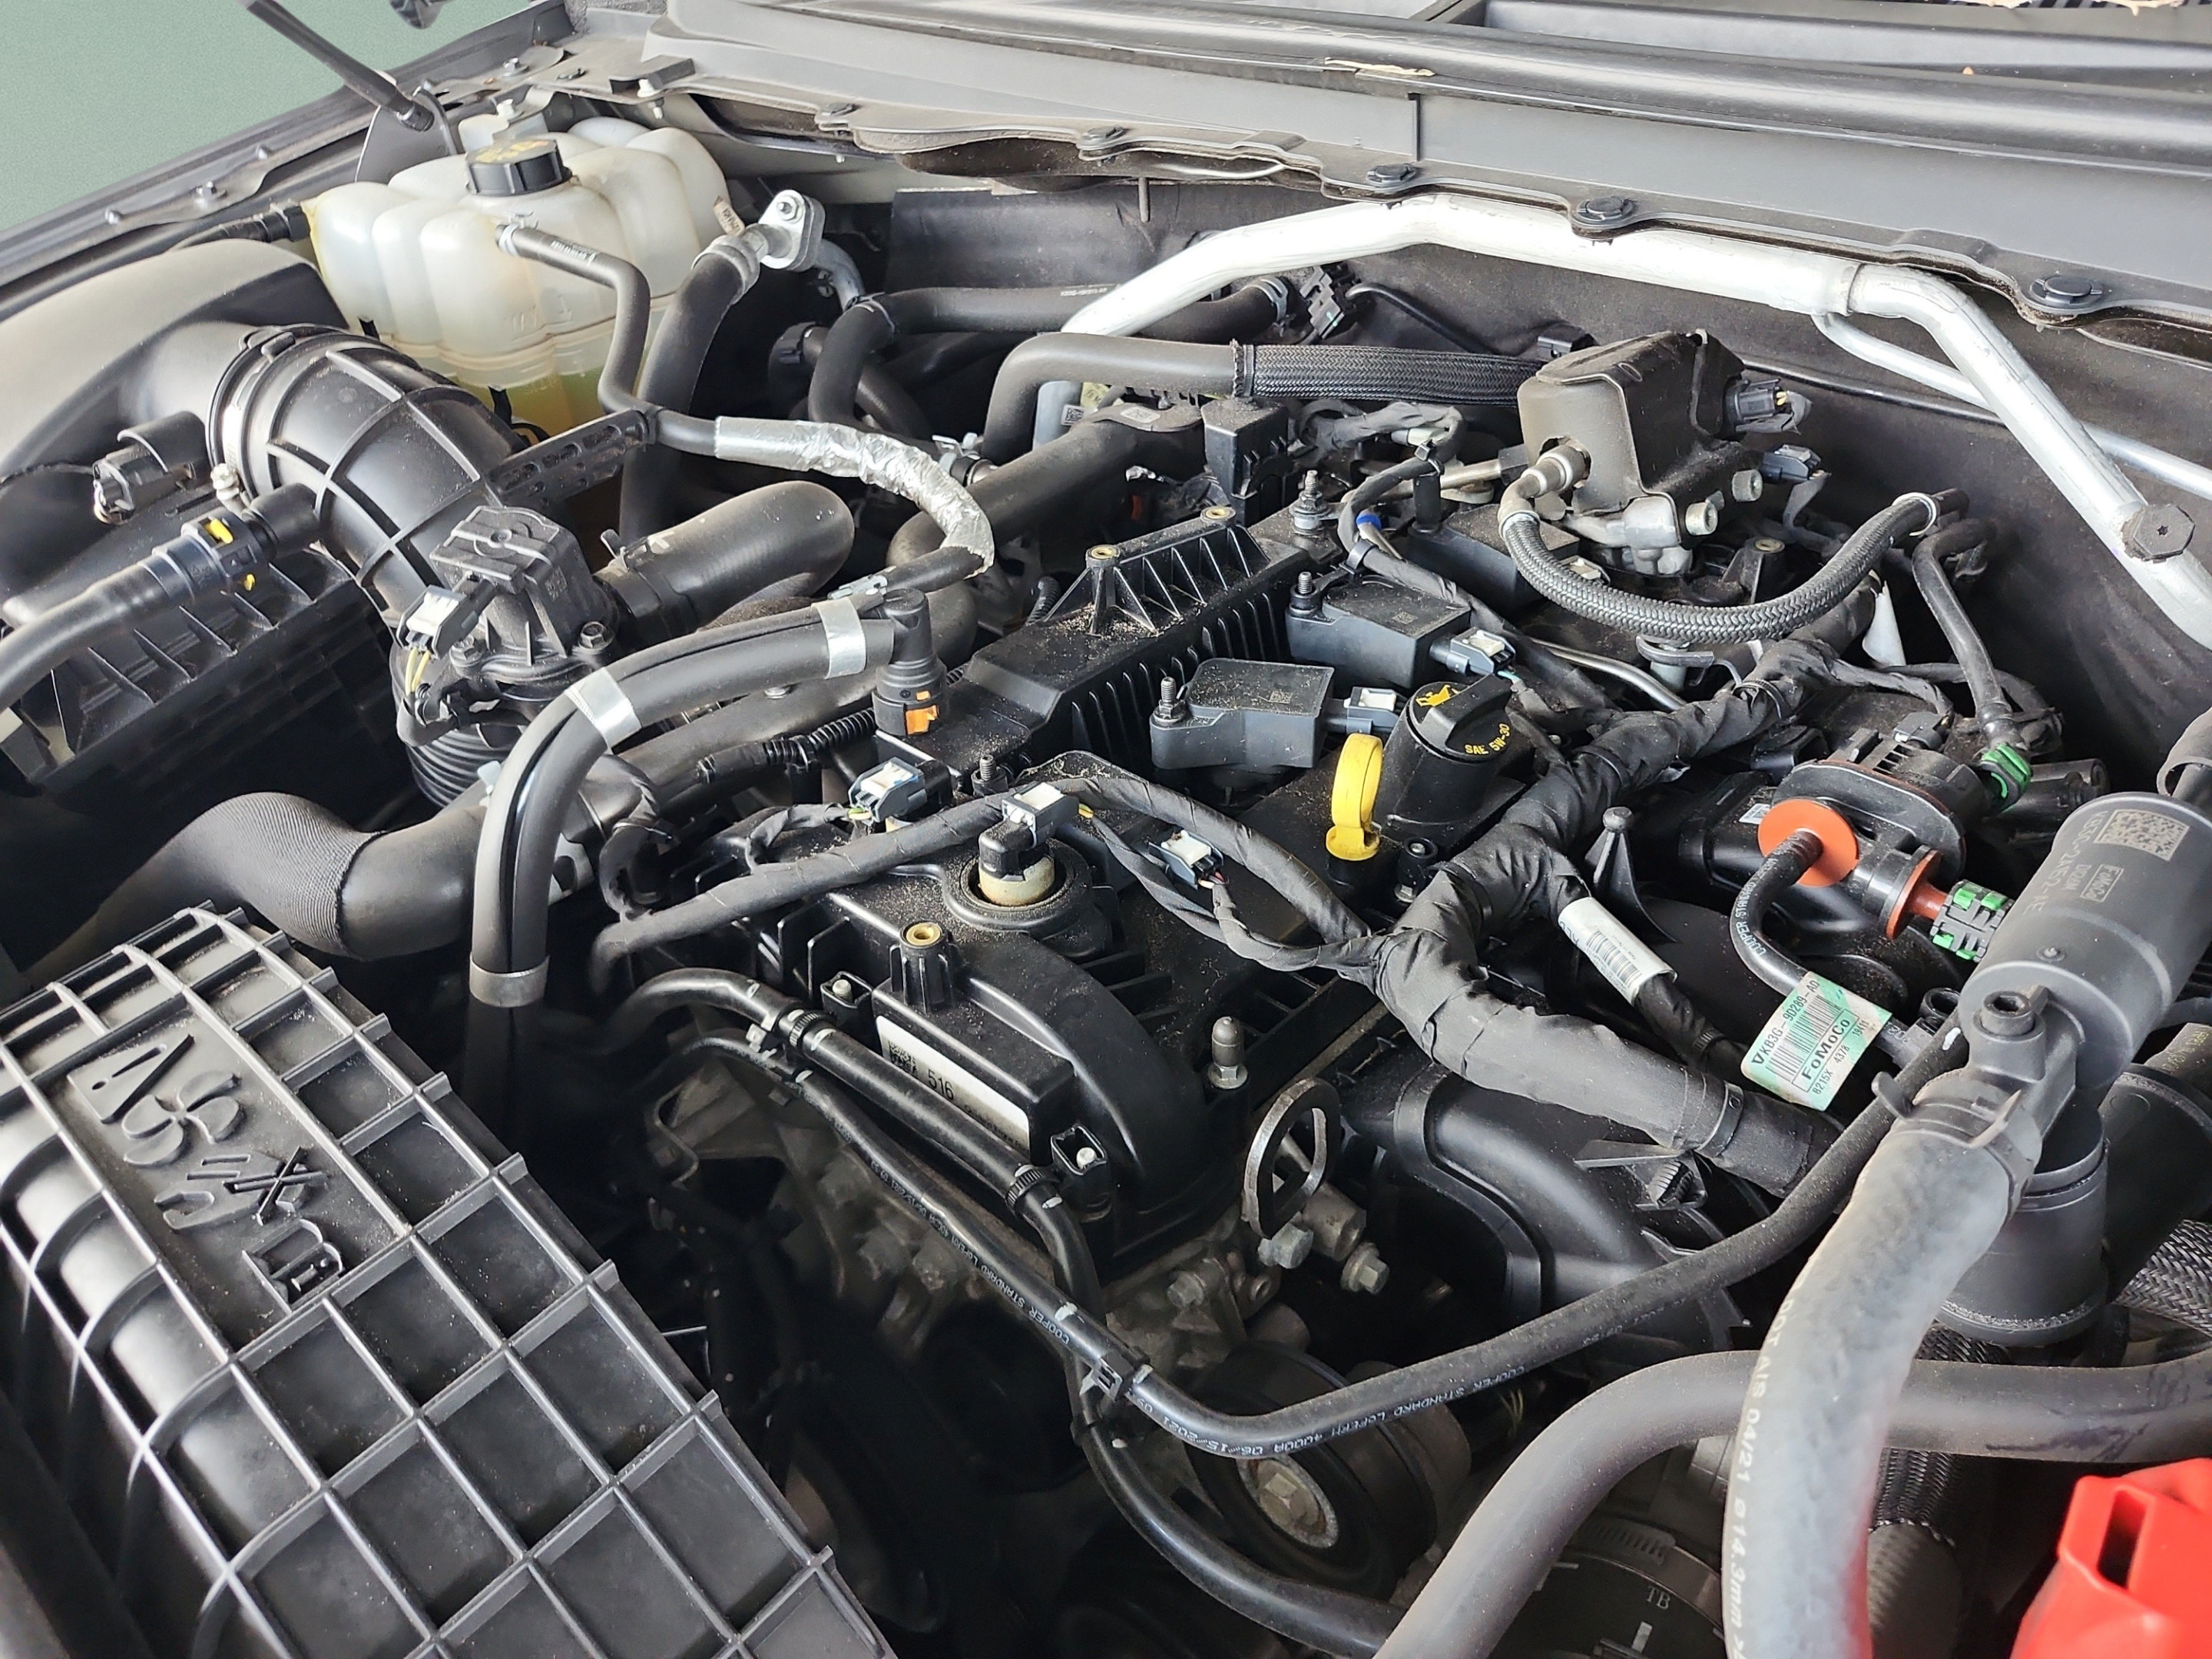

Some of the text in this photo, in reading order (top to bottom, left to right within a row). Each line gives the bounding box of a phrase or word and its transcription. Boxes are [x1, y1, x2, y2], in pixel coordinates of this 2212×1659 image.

[1464, 723, 1511, 755] SAE 5W-30
[1735, 921, 1767, 956] COOPER
[1801, 1018, 1850, 1080] FoMoCo
[1833, 1045, 1851, 1064] 4378
[927, 1068, 955, 1101] 516
[981, 1265, 1026, 1309] STANDARD
[1028, 1306, 1071, 1345] COOPER
[1769, 1298, 1795, 1346] DOT
[1472, 1366, 1525, 1392] COOPER
[1750, 1355, 1771, 1399] AIS
[1392, 1386, 1465, 1417] STANDARD
[1734, 1408, 1760, 1482] 04/21
